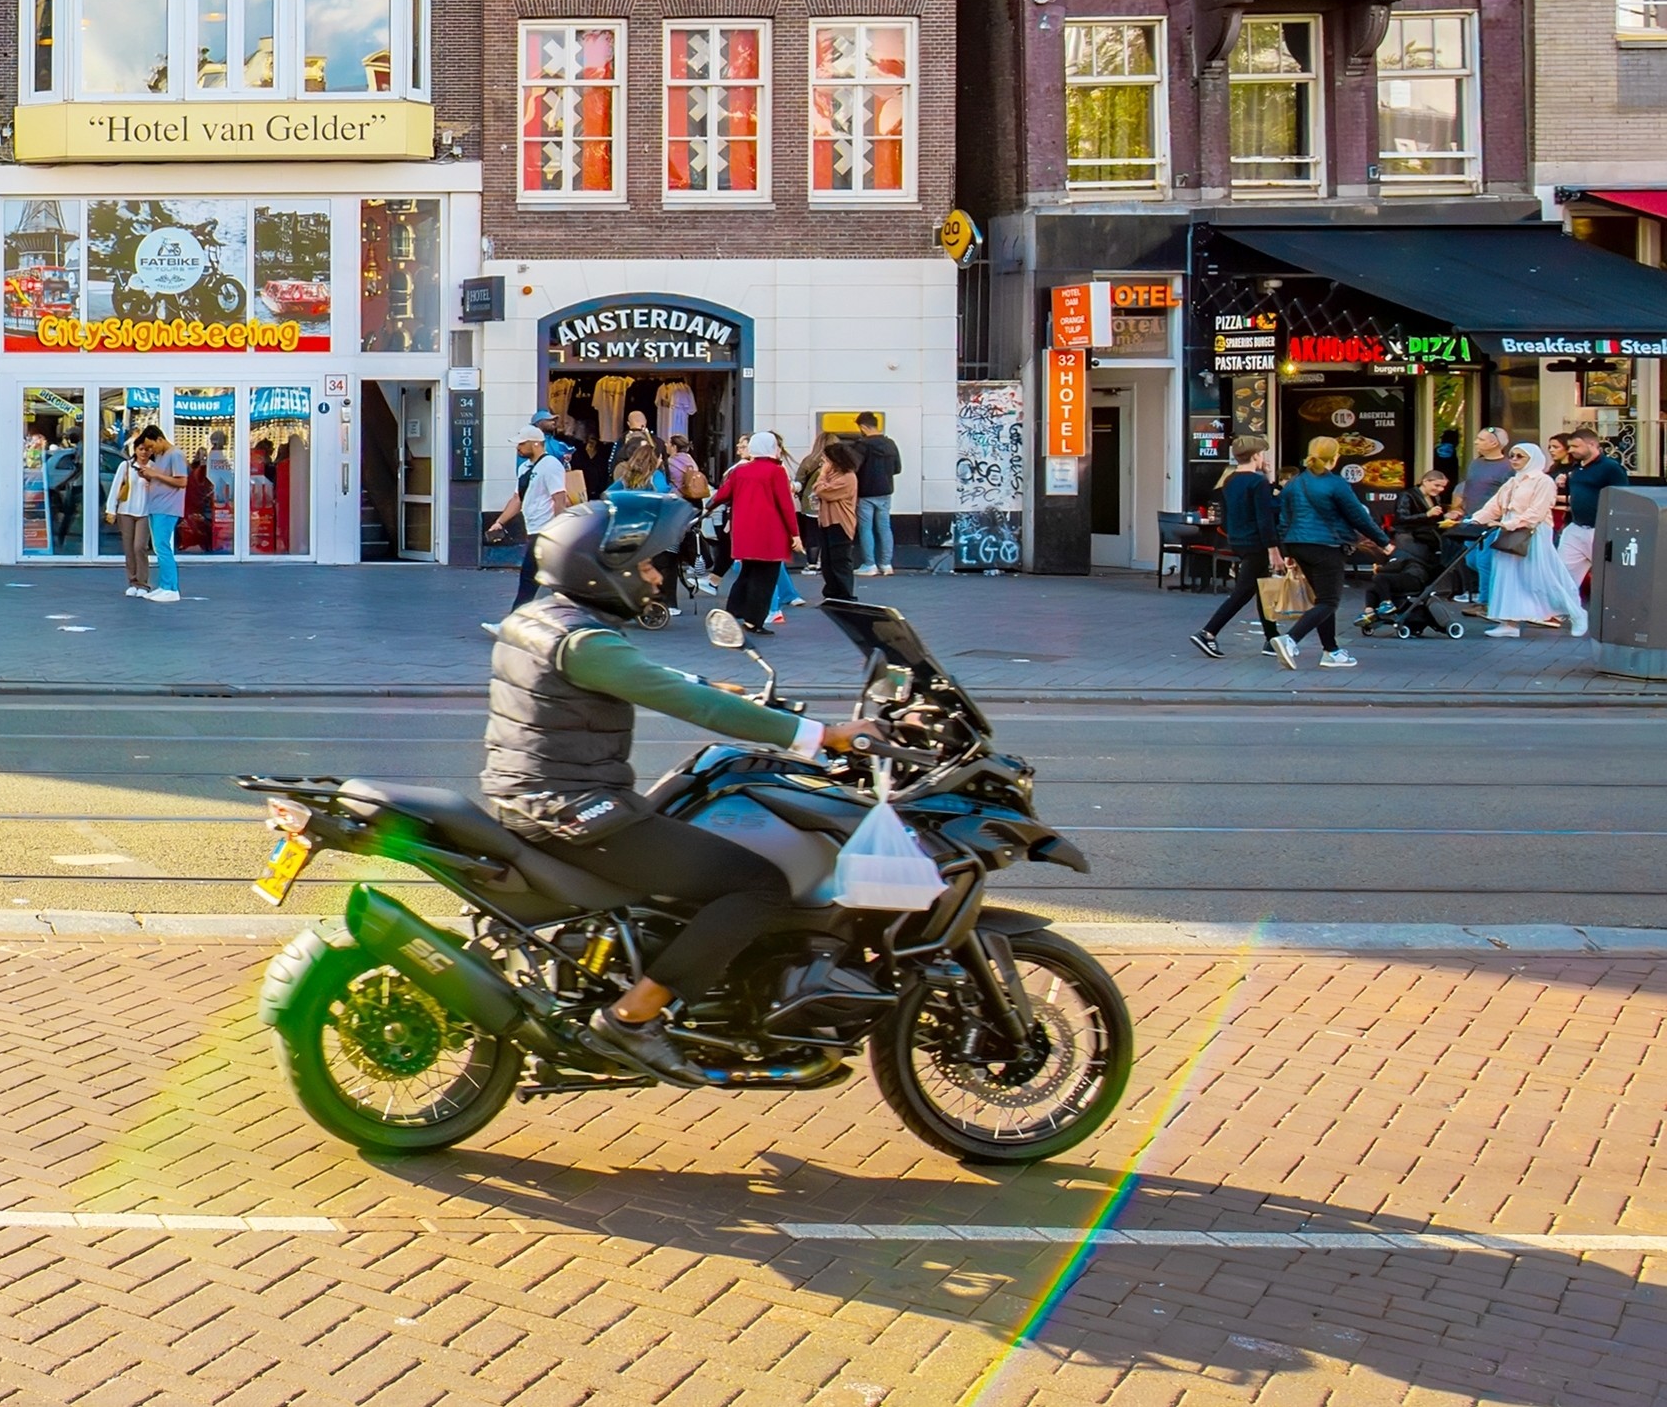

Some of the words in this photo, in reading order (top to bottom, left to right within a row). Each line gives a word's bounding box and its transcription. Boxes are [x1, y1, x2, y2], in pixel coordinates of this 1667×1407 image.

[202, 122, 254, 141] van
[140, 258, 200, 266] FATBIKE
[470, 289, 491, 302] HOTEL
[1061, 288, 1082, 297] HOTEL
[1111, 285, 1180, 307] OTEL
[558, 308, 732, 346] AMSTERDAM
[1215, 315, 1243, 330] PIZZA
[38, 315, 302, 352] CitySightseeing
[1254, 336, 1275, 347] BURGER
[1502, 337, 1591, 353] Breakfast
[580, 342, 600, 357] IS
[607, 342, 638, 357] MY
[643, 341, 707, 358] STYLE
[1058, 355, 1075, 366] 32
[1374, 364, 1406, 374] burgers
[329, 380, 344, 391] 34
[39, 389, 76, 414] DISCOUNT
[460, 398, 474, 408] 34
[1059, 371, 1074, 453] HOTEL
[462, 427, 472, 477] HOTEL
[1199, 448, 1218, 456] PIZZA
[576, 800, 615, 823] HUGO
